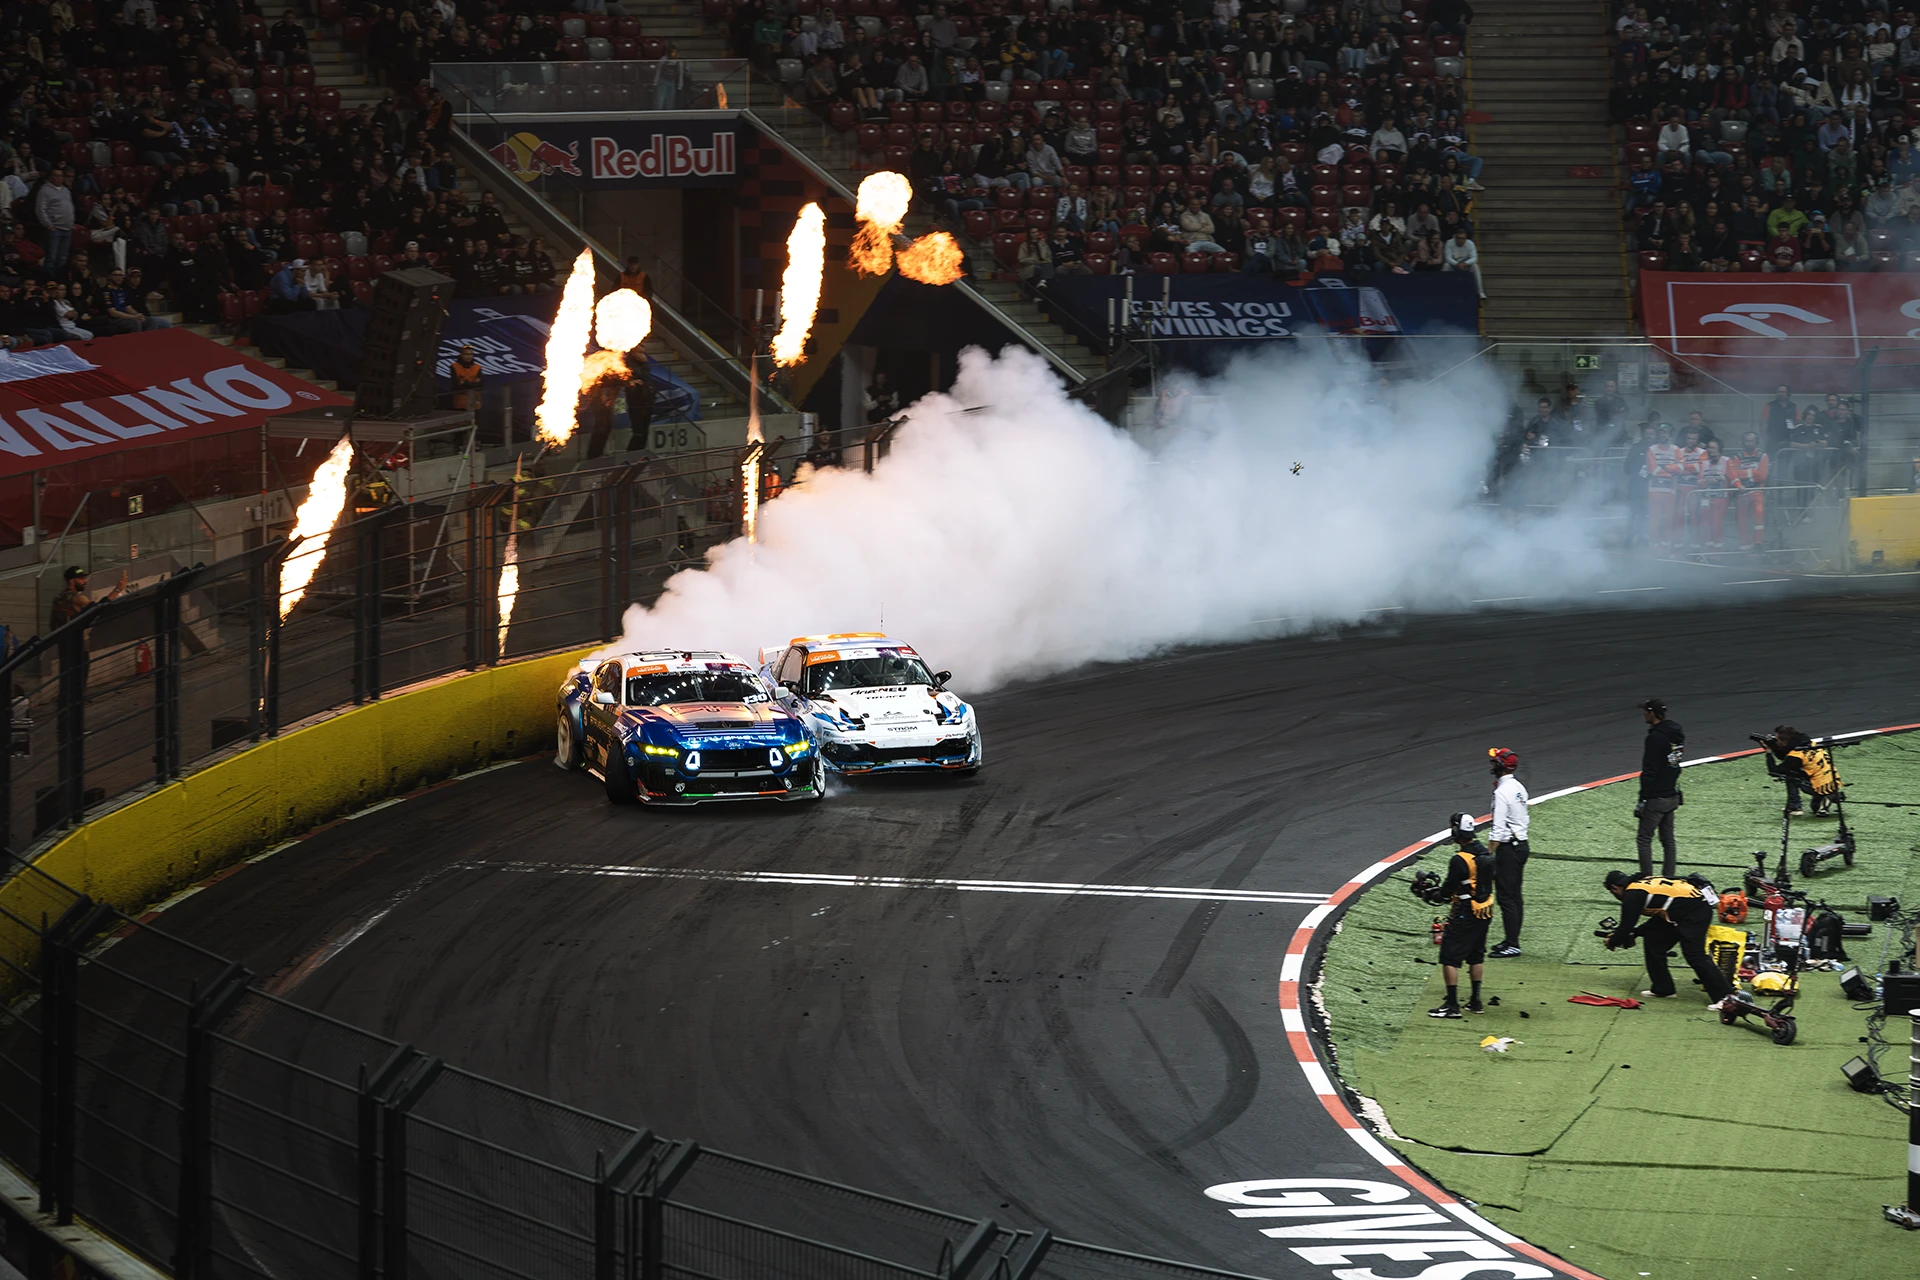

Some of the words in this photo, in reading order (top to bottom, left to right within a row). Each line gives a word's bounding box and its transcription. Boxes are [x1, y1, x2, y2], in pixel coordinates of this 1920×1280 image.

[1220, 302, 1293, 317] YOU
[1357, 315, 1396, 327] Bull
[654, 430, 688, 449] D18
[742, 692, 768, 705] 130
[1203, 1178, 1554, 1280] GIVES
